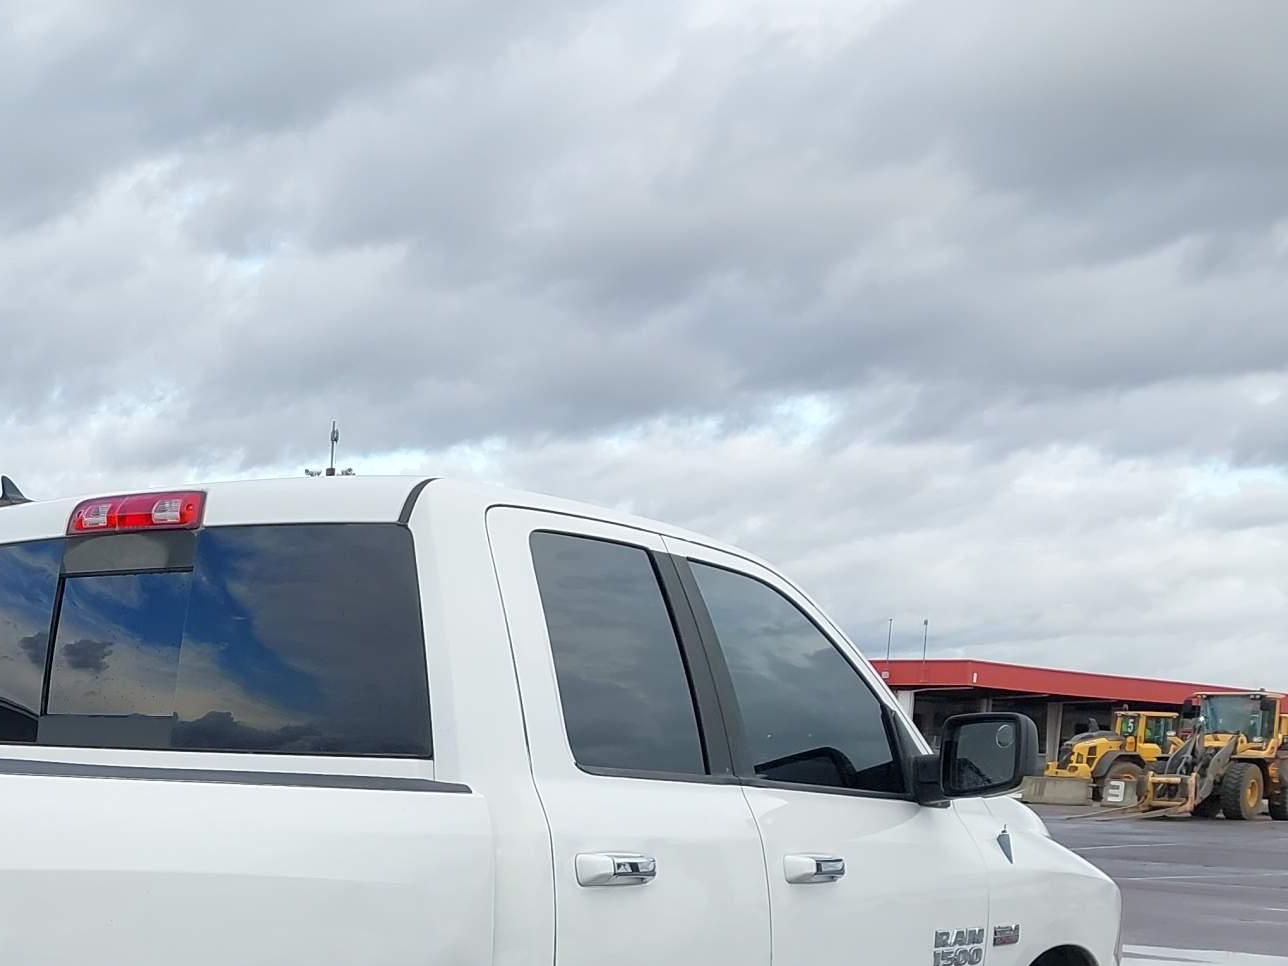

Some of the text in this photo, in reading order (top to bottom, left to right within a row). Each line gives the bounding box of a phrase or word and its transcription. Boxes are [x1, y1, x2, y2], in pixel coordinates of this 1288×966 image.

[1126, 718, 1135, 733] 5
[1107, 780, 1126, 802] 3
[933, 928, 985, 948] RAM
